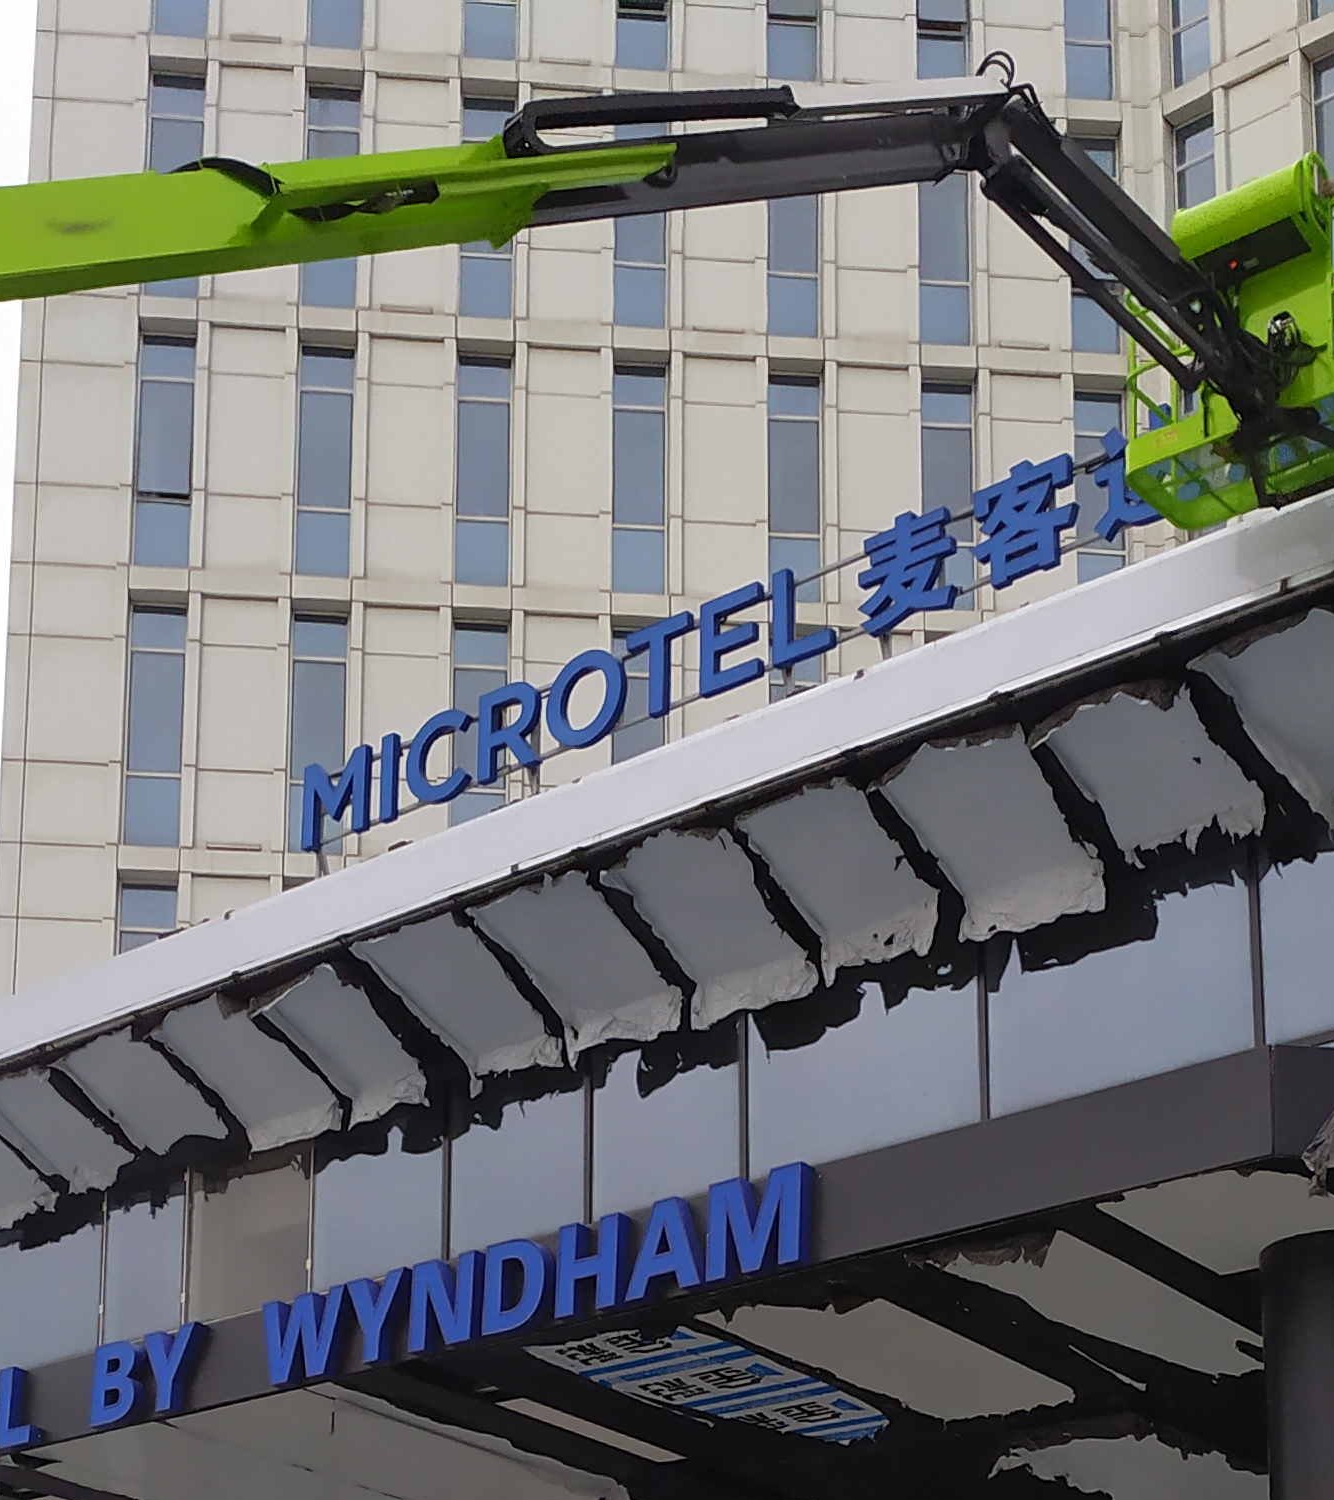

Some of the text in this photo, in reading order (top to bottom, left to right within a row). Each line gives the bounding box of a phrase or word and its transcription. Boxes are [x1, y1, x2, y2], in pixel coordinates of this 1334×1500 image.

[301, 568, 838, 852] MICROTEL
[88, 1320, 207, 1426] BY
[262, 1161, 814, 1387] WYNDHAM
